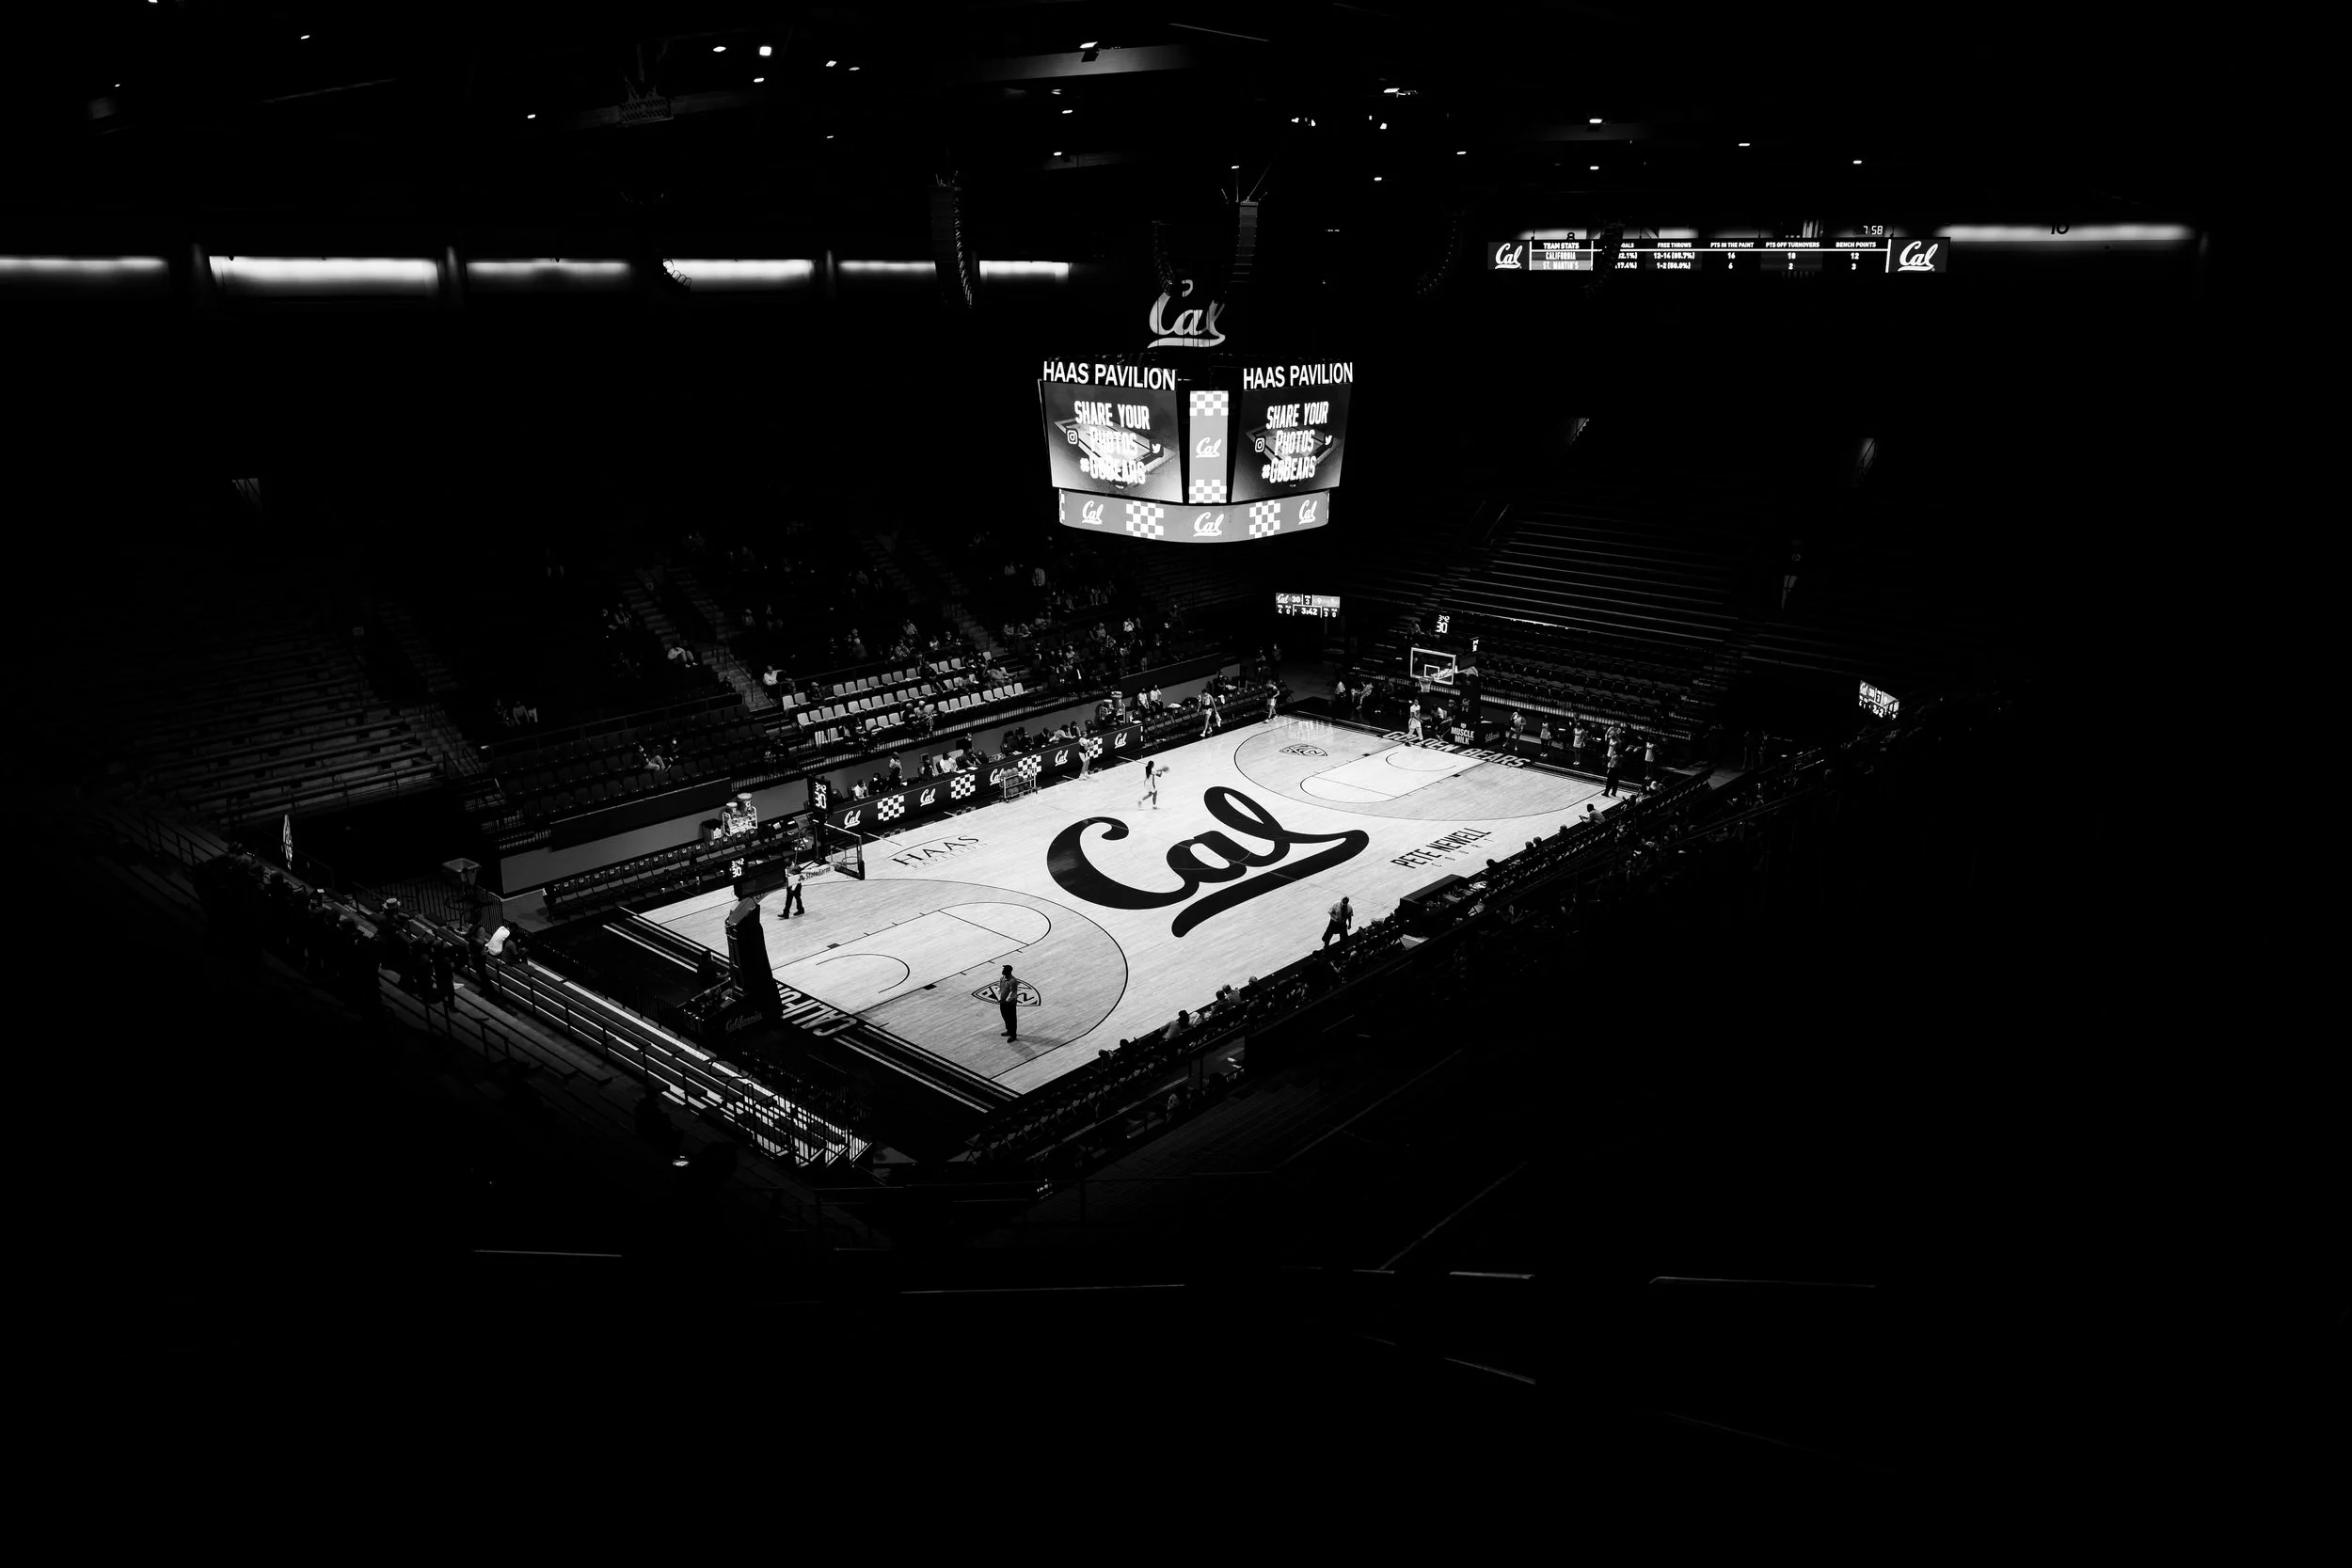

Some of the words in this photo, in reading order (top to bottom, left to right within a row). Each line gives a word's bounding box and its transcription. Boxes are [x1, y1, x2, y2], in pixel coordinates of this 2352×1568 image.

[1863, 225, 1883, 235] 7:58
[1495, 243, 1523, 269] Cal
[1545, 251, 1576, 261] CALIFORNIA
[1727, 251, 1736, 260] 16
[1788, 251, 1797, 260] 18
[1851, 252, 1860, 261] 12
[1898, 241, 1938, 271] Cal
[1728, 261, 1733, 270] 6
[1851, 262, 1857, 271] 3
[1147, 279, 1227, 348] Cal
[1043, 360, 1089, 385] HAAS
[1094, 363, 1176, 391] PAVILION
[1243, 365, 1285, 390] HAAS
[1290, 361, 1353, 387] PAVILION
[1073, 400, 1113, 426] SHARE
[1117, 404, 1151, 430] YOUR
[1265, 404, 1300, 430] SHARE
[1303, 401, 1329, 426] YOUR
[1089, 426, 1138, 456] PHOTOS
[1195, 436, 1222, 458] Cal
[1275, 429, 1315, 456] PHOTOS
[1082, 499, 1104, 525] Cal
[1297, 499, 1318, 526] Cal
[1193, 511, 1225, 537] Cal
[1291, 595, 1301, 604] 30
[1301, 607, 1318, 616] 3:42
[1436, 621, 1448, 634] 30
[1114, 733, 1128, 749] Cal
[1451, 726, 1475, 739] MUSCLE
[1055, 750, 1069, 767] Cal
[1458, 748, 1531, 767] BEARS
[990, 768, 1005, 785] Cal
[814, 791, 827, 809] 30
[920, 788, 935, 807] Cal
[844, 810, 862, 829] Cal
[892, 834, 979, 865] HAAS
[1391, 848, 1442, 869] PETE
[1425, 827, 1492, 853] NEWELL
[730, 865, 742, 878] 30
[1047, 786, 1369, 938] Cal
